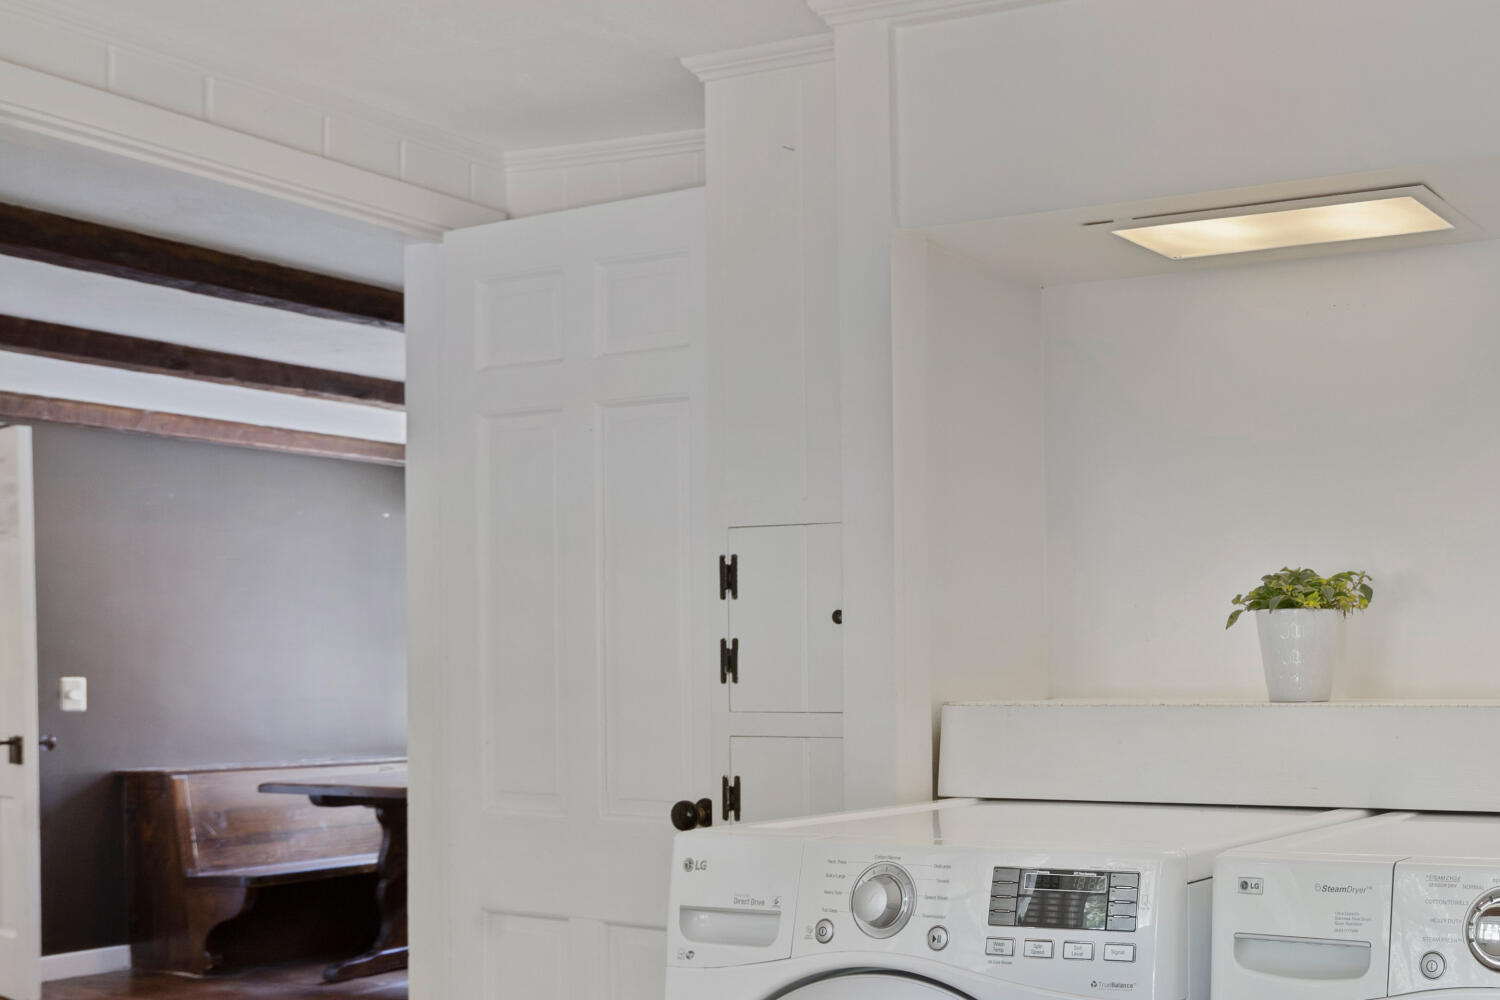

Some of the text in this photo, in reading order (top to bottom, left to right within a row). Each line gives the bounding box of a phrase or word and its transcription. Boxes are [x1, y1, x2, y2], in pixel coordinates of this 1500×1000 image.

[695, 860, 708, 871] LG
[733, 897, 765, 906] Direct Drive
